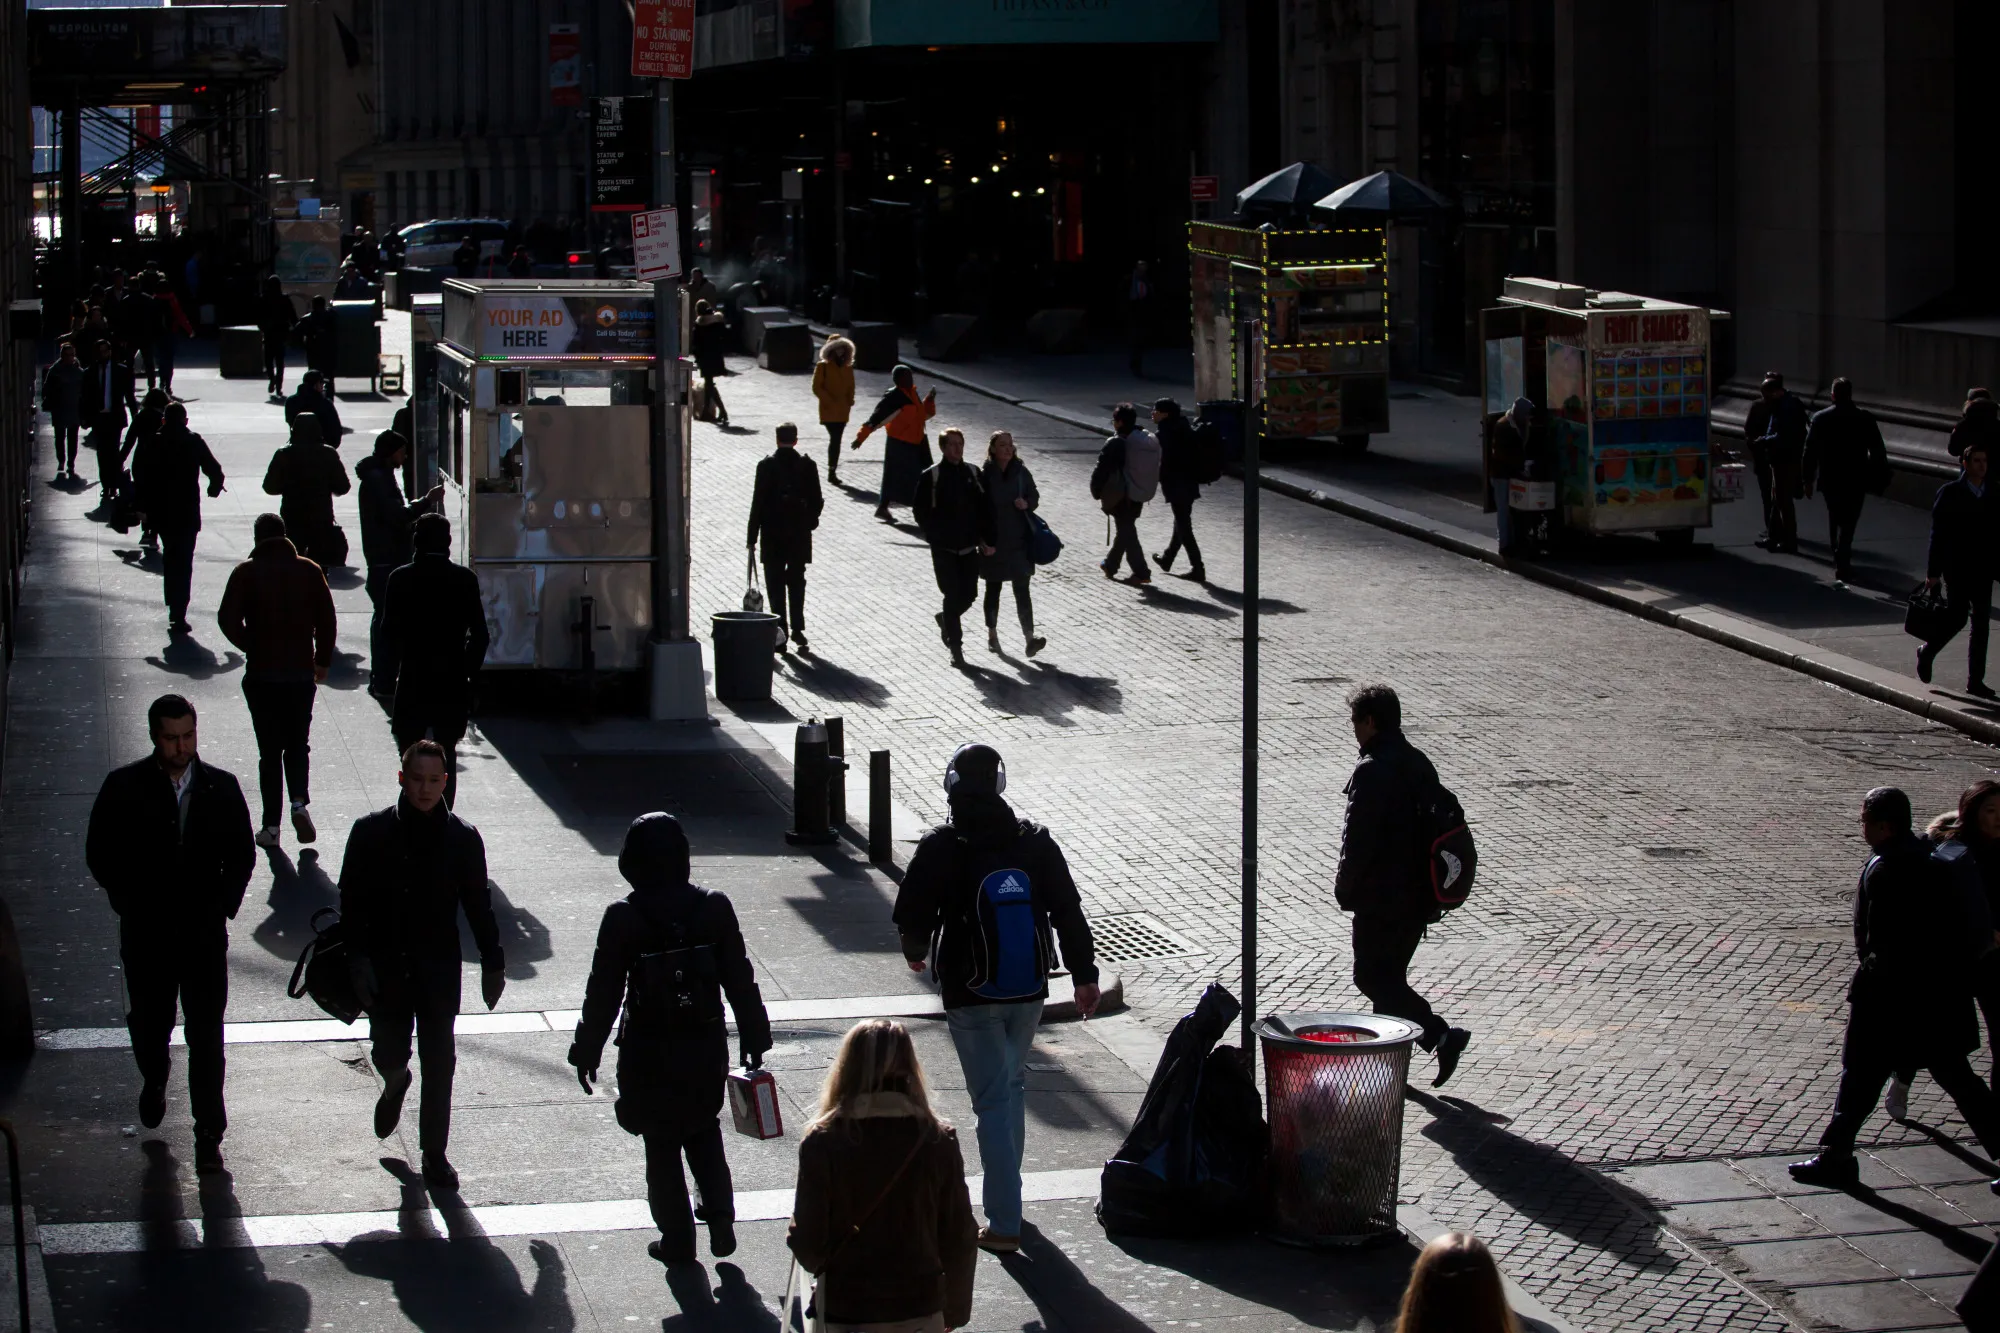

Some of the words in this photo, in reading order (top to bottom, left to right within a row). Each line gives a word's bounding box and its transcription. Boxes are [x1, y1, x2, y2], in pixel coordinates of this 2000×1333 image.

[48, 23, 128, 33] NEAPOLITAN
[637, 26, 648, 39] NO
[653, 27, 691, 42] STANDING
[649, 42, 677, 51] DURING
[640, 51, 685, 63] EMERGENCY
[639, 62, 664, 72] VEHICLES
[668, 63, 685, 73] TOWED
[487, 309, 534, 327] YOUR
[539, 309, 563, 327] AD
[617, 329, 637, 338] Today!
[1604, 315, 1638, 344] FRUIT
[1642, 314, 1689, 342] SHAKES
[503, 330, 548, 347] HERE
